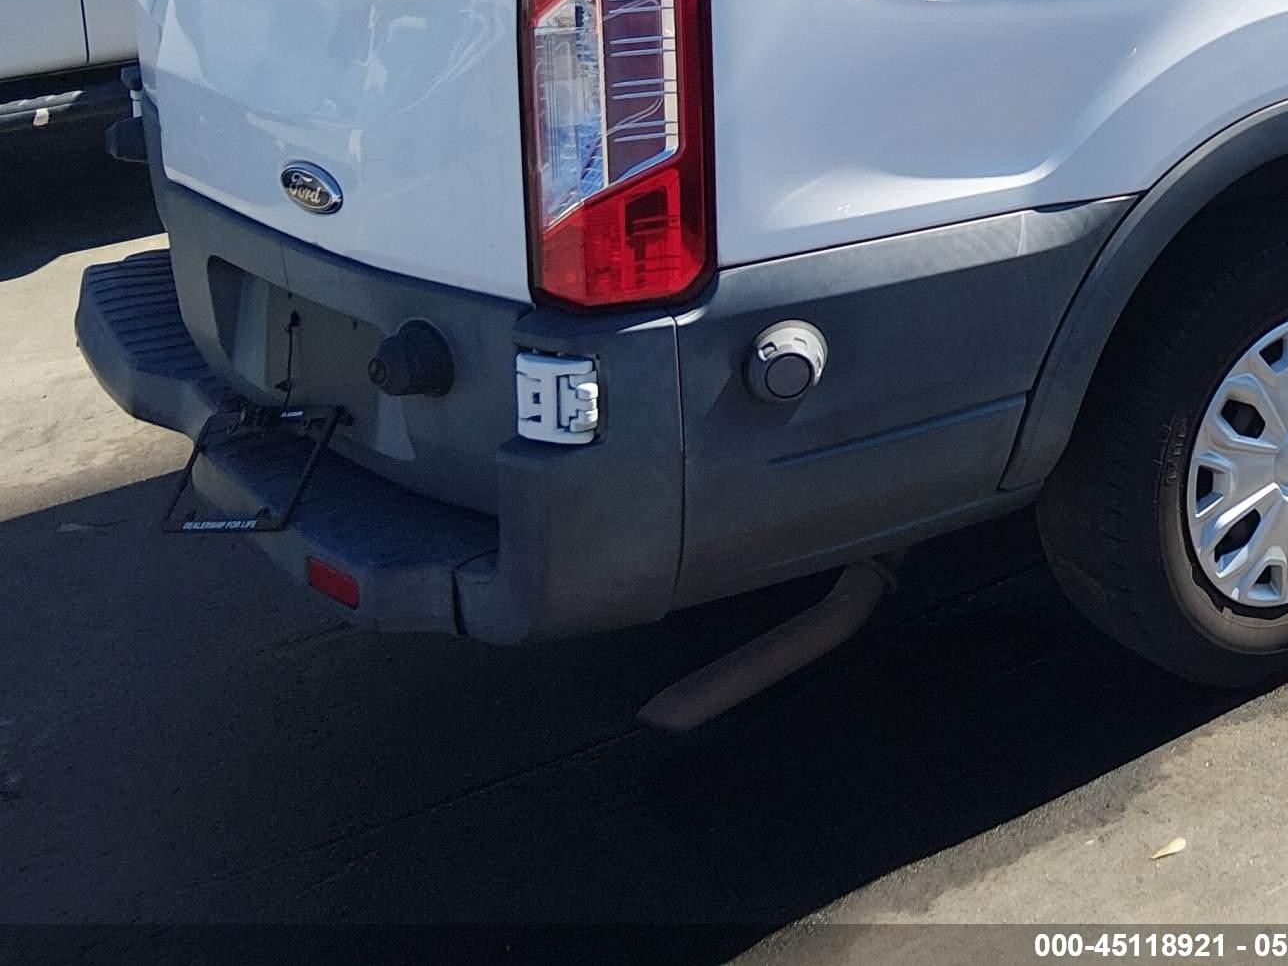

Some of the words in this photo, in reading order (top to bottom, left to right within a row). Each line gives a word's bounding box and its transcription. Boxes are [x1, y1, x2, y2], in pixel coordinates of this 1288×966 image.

[288, 172, 322, 204] Ford
[225, 520, 241, 529] FOR
[240, 519, 257, 529] LIFE
